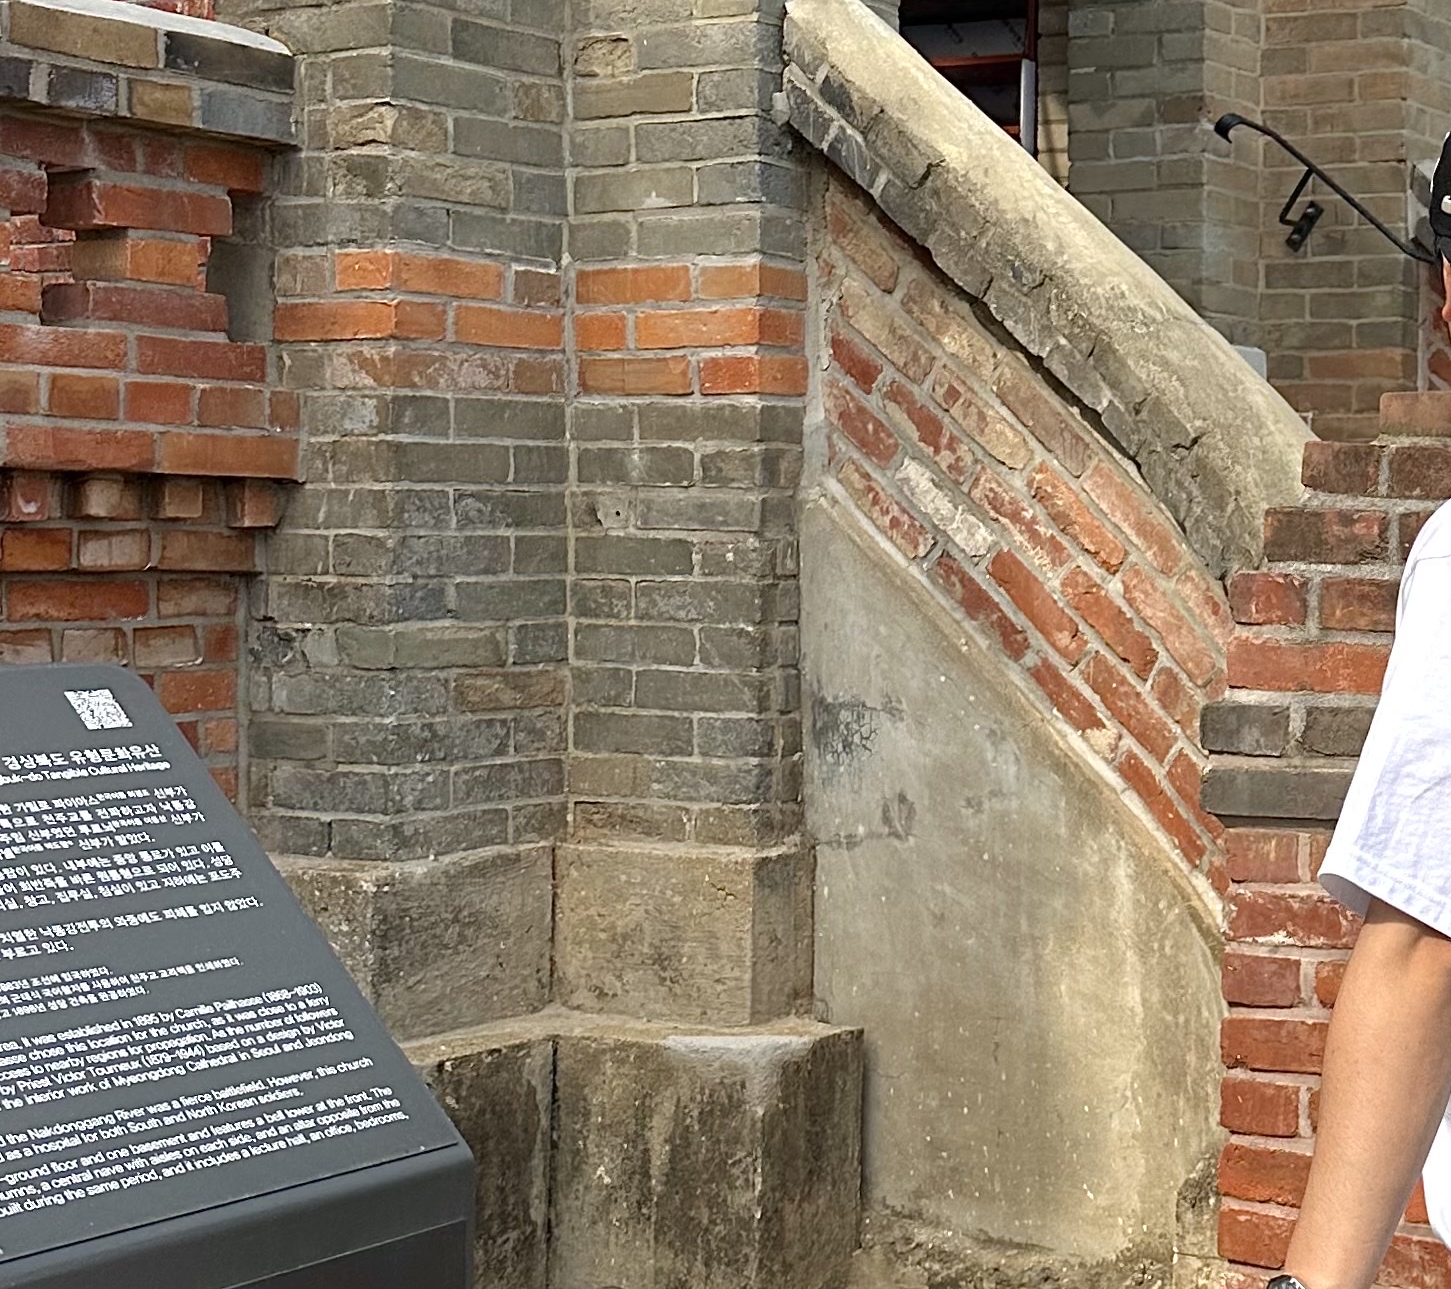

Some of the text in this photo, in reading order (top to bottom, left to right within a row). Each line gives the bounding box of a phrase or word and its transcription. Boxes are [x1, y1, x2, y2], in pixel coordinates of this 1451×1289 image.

[2, 744, 162, 770] 경상북도 유형문화유산
[41, 768, 89, 779] Tangible
[88, 764, 128, 775] Cultural
[126, 762, 170, 772] Heritage
[95, 803, 157, 819] 전파하고자
[154, 786, 187, 799] 신부가
[28, 826, 77, 841] 신부였던
[171, 812, 205, 825] 신부가
[79, 836, 114, 850] 신부가
[30, 842, 225, 875] 있다. 내부에는 중앙 통로가 있고 이를
[156, 862, 181, 873] 되어
[181, 858, 210, 871] 있다.
[211, 855, 233, 867] 성당
[98, 882, 135, 897] 침실이
[135, 880, 161, 892] 있고
[161, 874, 208, 887] 지하에는
[208, 868, 242, 881] 포도주
[39, 918, 113, 937] 낙동강전투의
[114, 912, 162, 926] 와중에도
[162, 906, 199, 919] 피해를
[199, 902, 224, 914] 입지
[224, 896, 263, 911] 않았다.
[1, 940, 74, 959] 부르고 있다.
[21, 1037, 31, 1047] It
[31, 1034, 56, 1045] was
[57, 1021, 121, 1040] established
[120, 1019, 133, 1028] in
[158, 1012, 174, 1022] by
[175, 1005, 214, 1019] Camille
[29, 996, 329, 1060] chose this location for the church, as it was close to ferry
[30, 1065, 44, 1074] to
[44, 1057, 84, 1072] nearby
[86, 1049, 128, 1063] regions
[127, 1045, 143, 1055] for
[212, 1029, 227, 1039] As
[225, 1027, 244, 1036] the
[244, 1019, 283, 1032] number
[284, 1015, 295, 1024] of
[294, 1008, 338, 1022] followers
[2, 1031, 354, 1109] the interior work of Myeongdong Cathedral in Seoul and Jeondong
[16, 1019, 344, 1091] Priest Victor based on design by Victor
[6, 1134, 28, 1144] the
[27, 1115, 116, 1140] Nakdonggang
[114, 1108, 145, 1121] River
[146, 1102, 171, 1114] was
[180, 1094, 213, 1106] fierce
[266, 1071, 318, 1087] However,
[316, 1065, 337, 1076] this
[337, 1057, 373, 1072] church
[5, 1150, 22, 1160] as
[32, 1134, 82, 1154] hospital
[81, 1133, 98, 1143] for
[99, 1125, 128, 1139] both
[127, 1118, 163, 1132] South
[163, 1111, 187, 1125] and
[185, 1105, 218, 1119] North
[216, 1097, 258, 1112] Korean
[50, 1160, 78, 1172] floor
[80, 1152, 105, 1166] and
[106, 1149, 129, 1160] one
[129, 1134, 188, 1154] basement
[188, 1127, 211, 1141] and
[210, 1120, 255, 1135] features
[263, 1110, 285, 1123] bell
[284, 1105, 314, 1118] tower
[316, 1101, 328, 1111] at
[326, 1098, 345, 1108] the
[370, 1088, 392, 1097] The
[51, 1099, 400, 1188] central nave with aisles on each side, and an altar opposite from the
[24, 1194, 65, 1210] during
[64, 1189, 85, 1200] the
[86, 1181, 119, 1195] same
[120, 1169, 162, 1189] period,
[162, 1162, 186, 1177] and
[184, 1161, 194, 1171] it
[194, 1151, 241, 1169] includes
[248, 1141, 286, 1155] lecture
[285, 1133, 310, 1146] hall,
[309, 1131, 325, 1141] an
